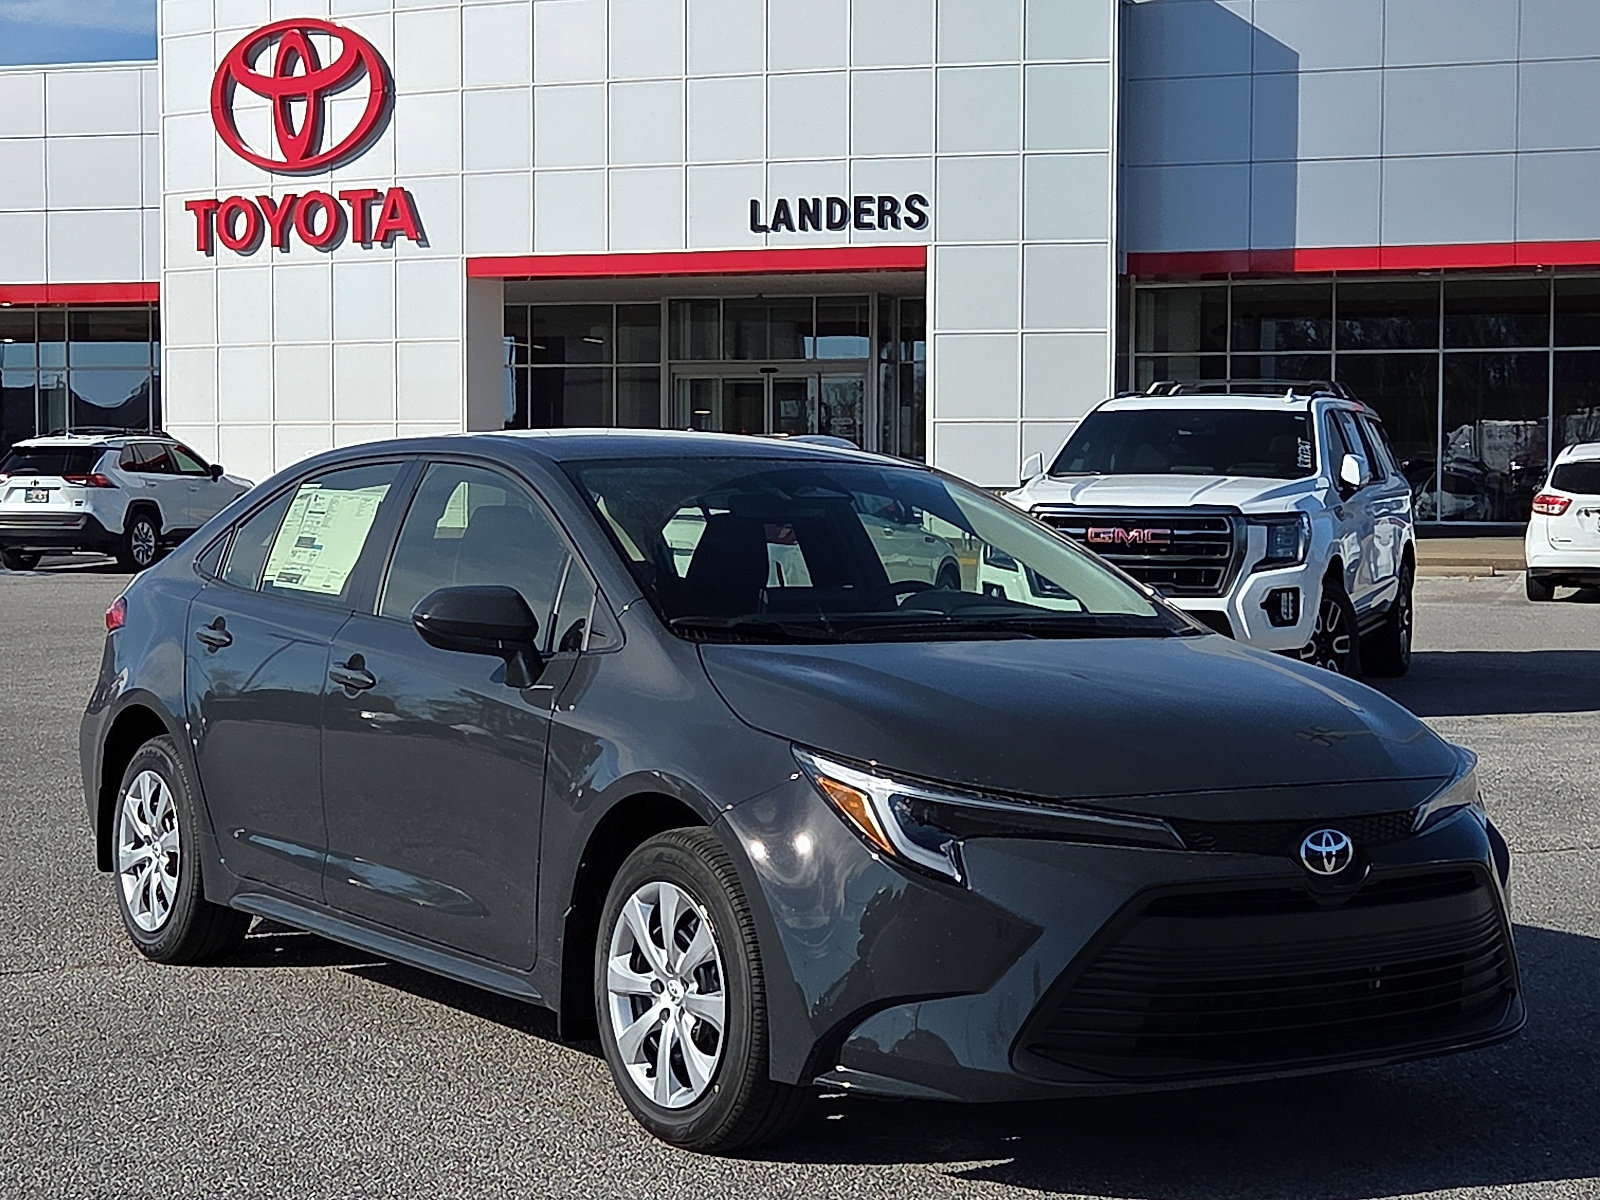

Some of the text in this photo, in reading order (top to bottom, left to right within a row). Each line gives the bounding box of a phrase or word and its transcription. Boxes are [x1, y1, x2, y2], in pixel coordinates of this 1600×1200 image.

[186, 187, 427, 255] TOYOTA
[750, 194, 929, 232] LANDERS
[1087, 527, 1171, 544] GMC
